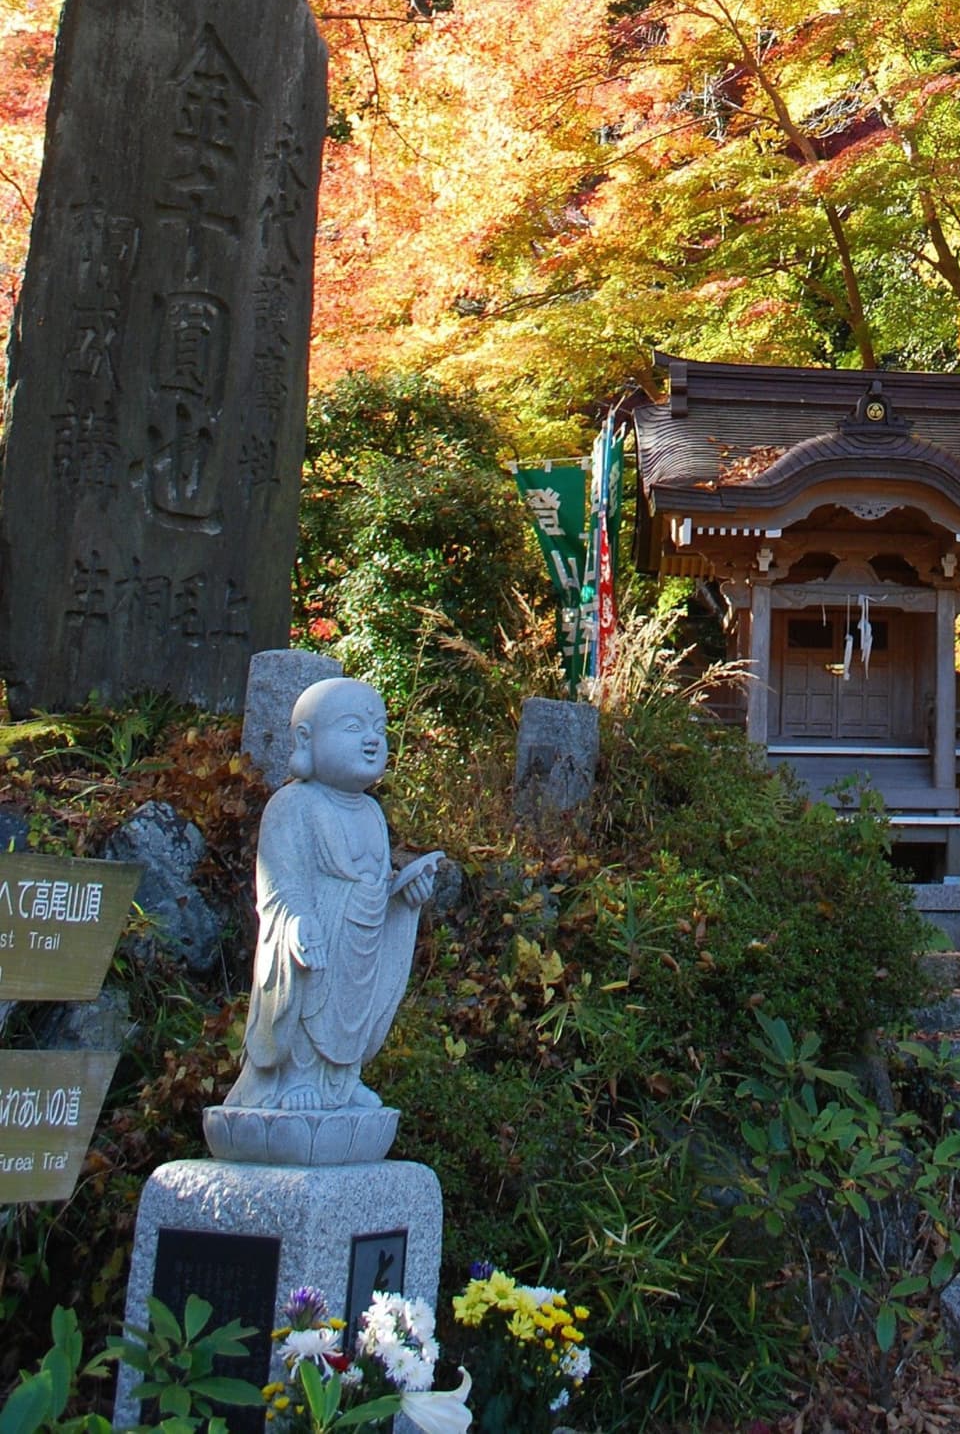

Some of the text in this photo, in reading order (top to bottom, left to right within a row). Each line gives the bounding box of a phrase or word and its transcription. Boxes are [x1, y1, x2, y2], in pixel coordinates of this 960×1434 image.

[0, 879, 103, 922] へて高尾山頂
[29, 931, 61, 951] Trail
